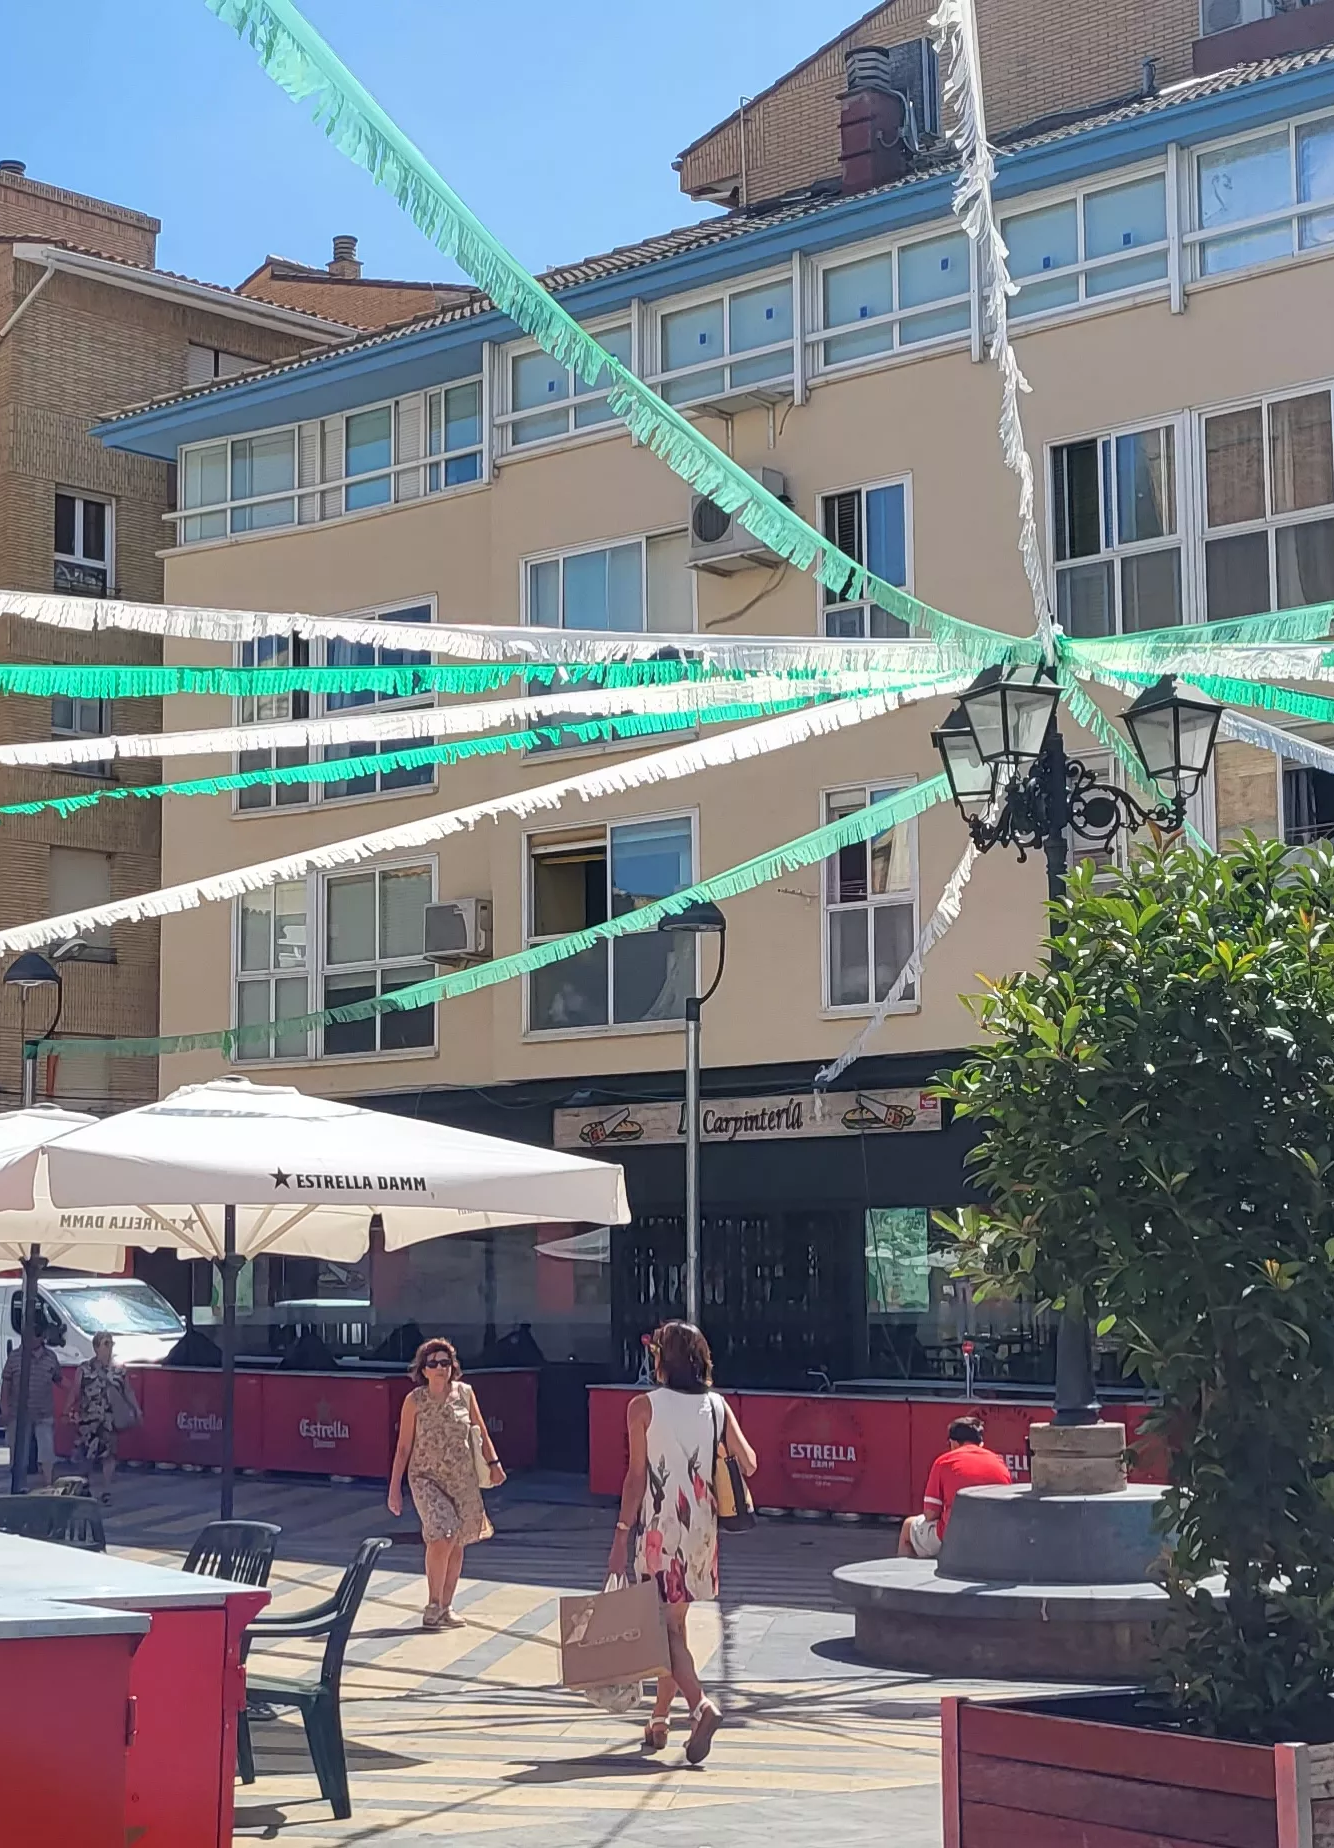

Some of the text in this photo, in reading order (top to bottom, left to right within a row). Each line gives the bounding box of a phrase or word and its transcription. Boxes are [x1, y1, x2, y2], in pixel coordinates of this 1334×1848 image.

[703, 1098, 803, 1141] Carpintería
[295, 1174, 427, 1191] ESTRELLA DAMM
[177, 1411, 223, 1431] Estrella
[299, 1418, 349, 1439] Estrella
[790, 1443, 856, 1462] ESTRELLA
